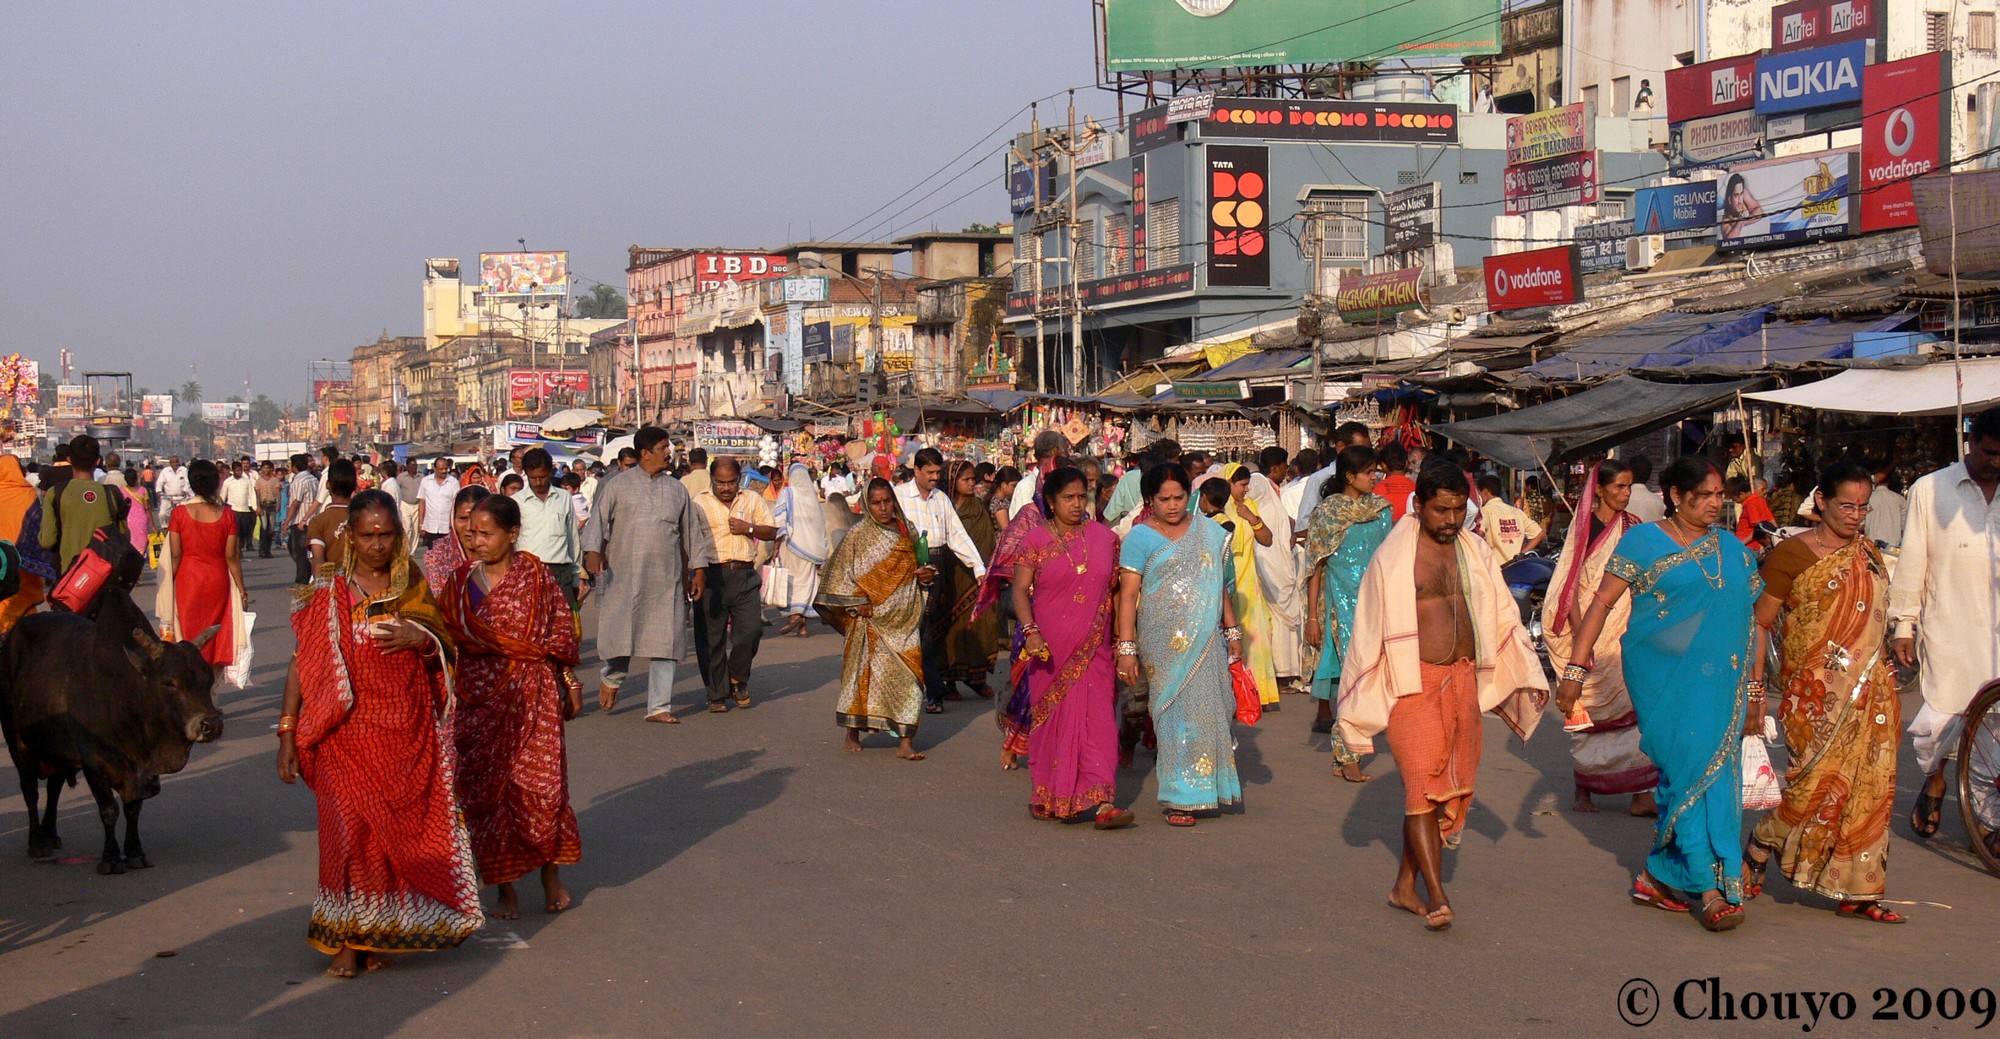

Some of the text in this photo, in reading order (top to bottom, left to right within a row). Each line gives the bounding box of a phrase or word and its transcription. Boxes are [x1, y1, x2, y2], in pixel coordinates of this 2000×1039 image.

[1784, 17, 1816, 42] Airtel
[1832, 5, 1867, 31] Airtel
[1714, 73, 1753, 104] Airtel
[1760, 57, 1858, 102] NOKIA
[1290, 111, 1368, 127] DOCOMO
[1375, 113, 1453, 128] DOCOMO
[1690, 114, 1766, 147] PHOTO EMPORIUM
[1212, 161, 1234, 169] TATA
[1868, 158, 1931, 182] vodafone
[1213, 171, 1264, 199] DO
[1212, 200, 1263, 228] CO
[1673, 207, 1697, 220] Mobile
[1804, 201, 1837, 214] SONATA
[1214, 229, 1265, 256] MO
[707, 256, 768, 274] IBD
[1365, 273, 1399, 285] HOTEL
[1510, 268, 1562, 290] vodafone
[701, 438, 728, 447] COLD
